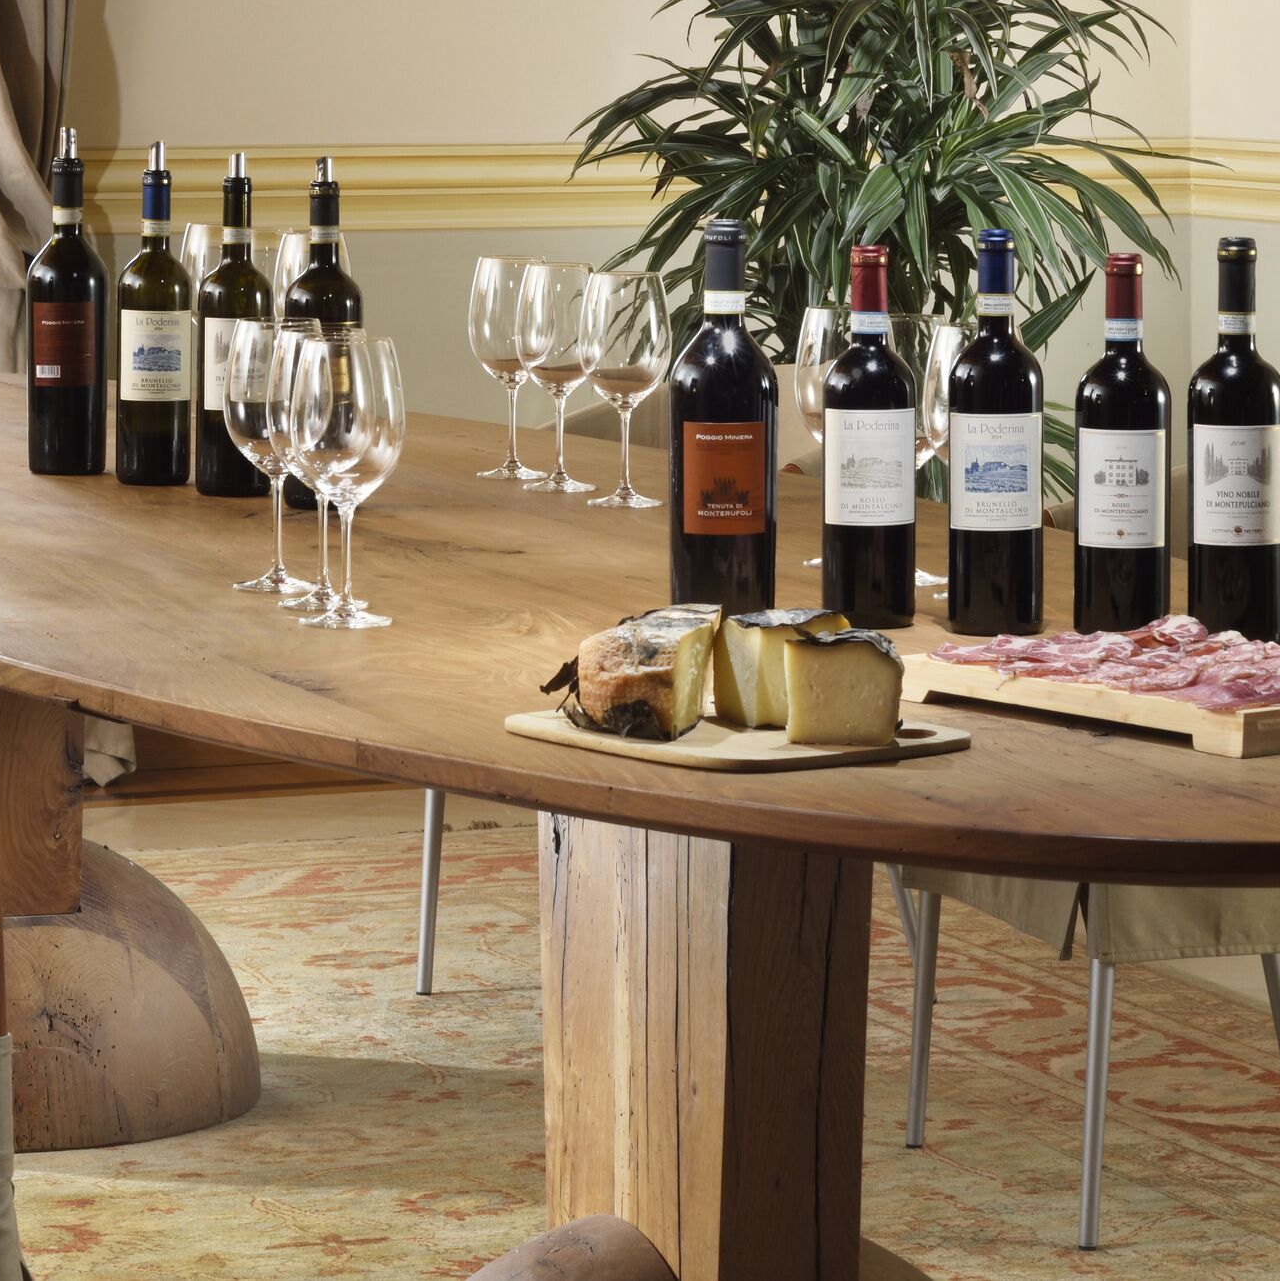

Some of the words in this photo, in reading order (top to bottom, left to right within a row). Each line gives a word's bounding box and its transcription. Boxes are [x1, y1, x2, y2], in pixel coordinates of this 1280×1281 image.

[844, 419, 853, 431] La
[857, 419, 900, 431] Poderina
[967, 423, 977, 434] La
[980, 423, 1024, 434] Poderina
[852, 502, 904, 510] MONTALCINO
[1214, 500, 1271, 509] MONTEPULCIANO
